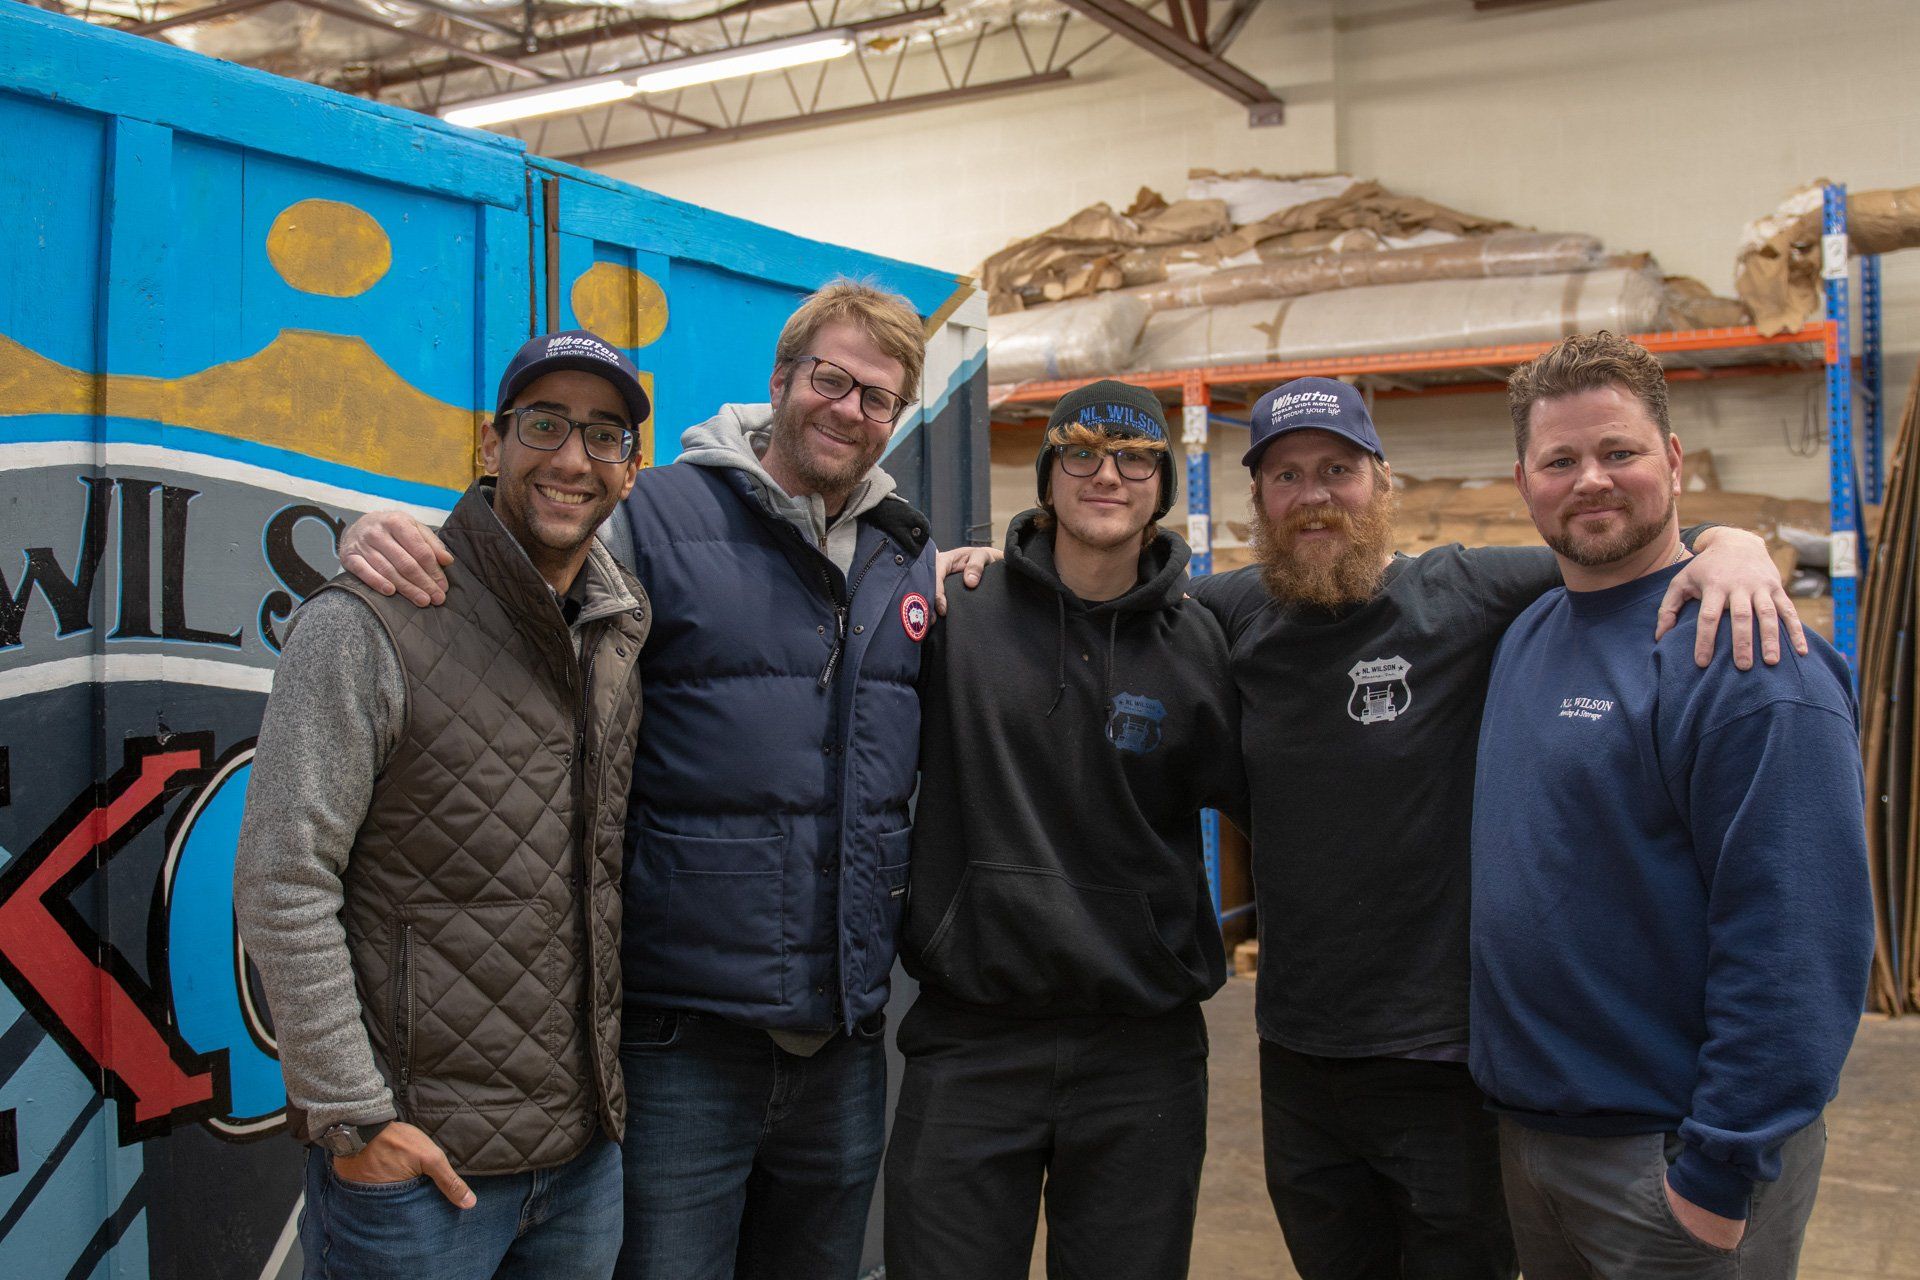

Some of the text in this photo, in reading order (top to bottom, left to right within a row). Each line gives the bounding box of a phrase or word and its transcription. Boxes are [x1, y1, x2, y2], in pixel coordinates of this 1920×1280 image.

[547, 335, 619, 361] Wheaton
[1271, 390, 1338, 412] Wheaton
[1272, 406, 1293, 417] WORLD
[1312, 401, 1340, 409] MOVING
[1283, 409, 1305, 420] move
[1305, 407, 1326, 415] your
[1106, 404, 1162, 440] WILSON
[1371, 663, 1396, 673] WILSON
[1573, 697, 1614, 712] WILSON
